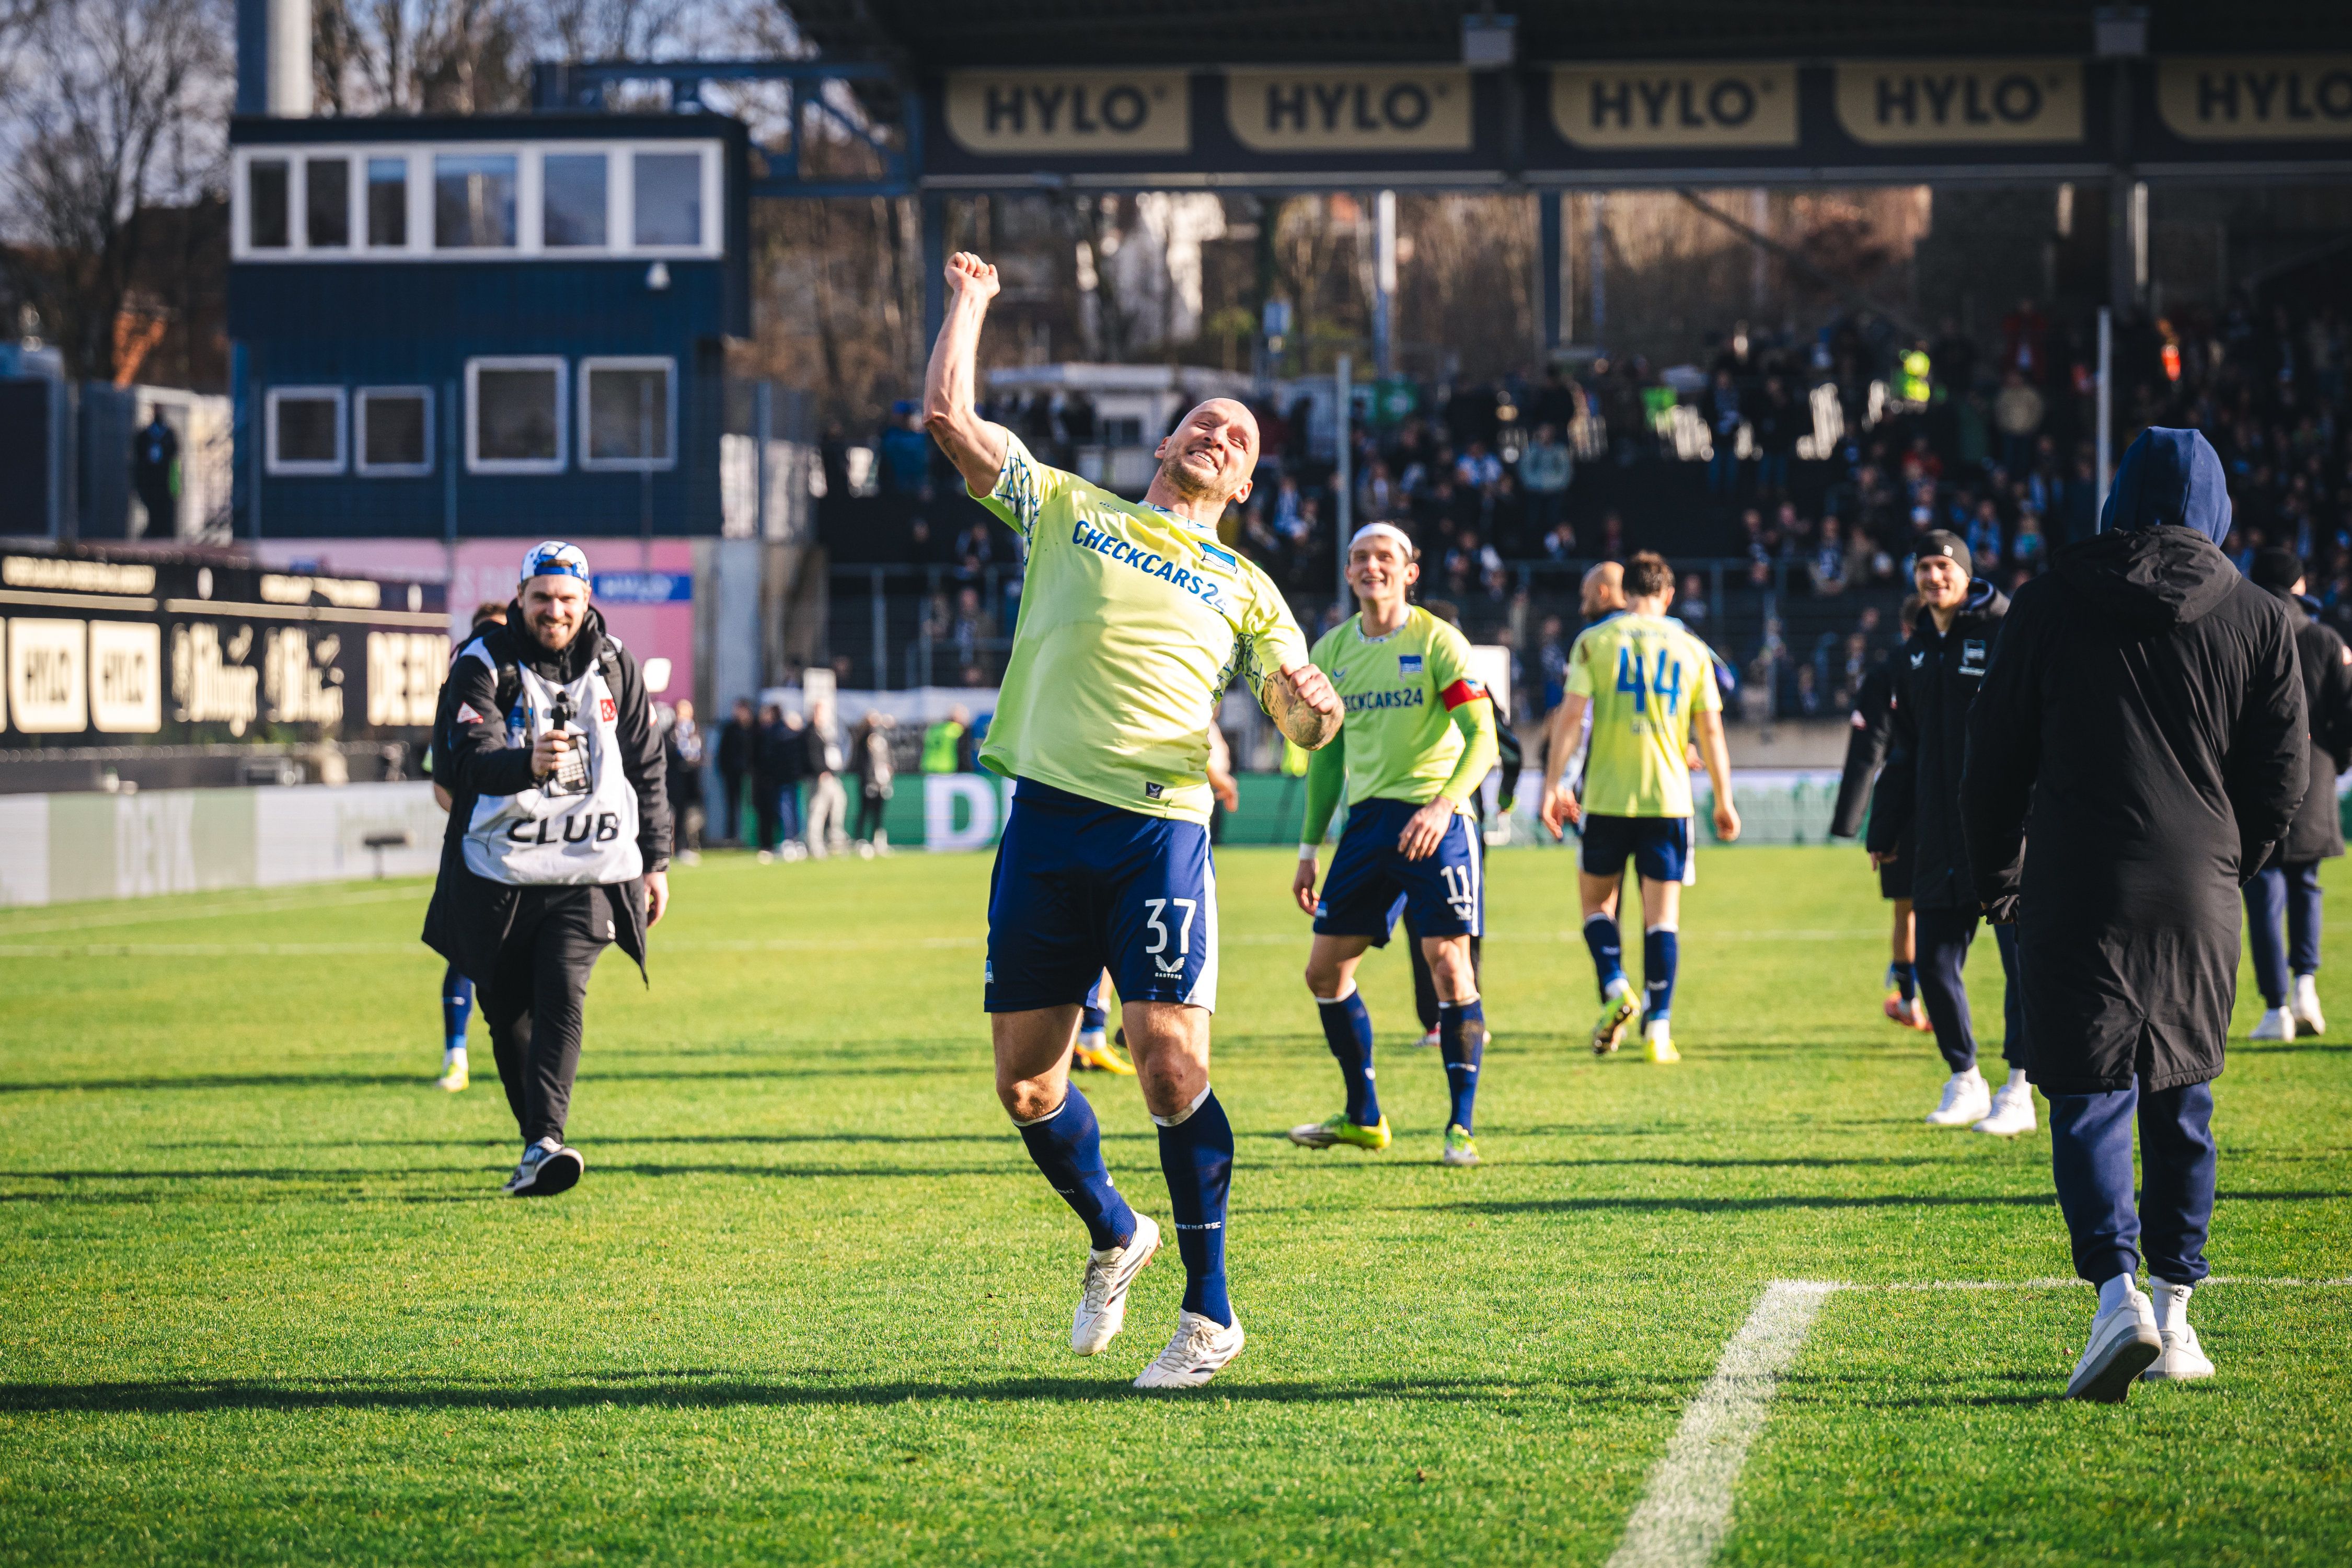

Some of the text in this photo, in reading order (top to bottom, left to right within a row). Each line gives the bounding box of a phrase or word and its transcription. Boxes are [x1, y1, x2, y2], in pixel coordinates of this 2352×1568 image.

[985, 84, 1148, 134] HYLO
[1266, 82, 1431, 133] HYLO
[1590, 78, 1756, 130] HYLO
[1876, 74, 2041, 125] HYLO
[1072, 520, 1227, 615] CHECKCARS24
[1344, 687, 1424, 712] ECKCARS24
[1616, 646, 1681, 716] 44
[507, 812, 619, 845] CLUB
[1440, 864, 1473, 905] 11
[1145, 897, 1197, 954] 37
[1204, 1221, 1221, 1229] BSC
